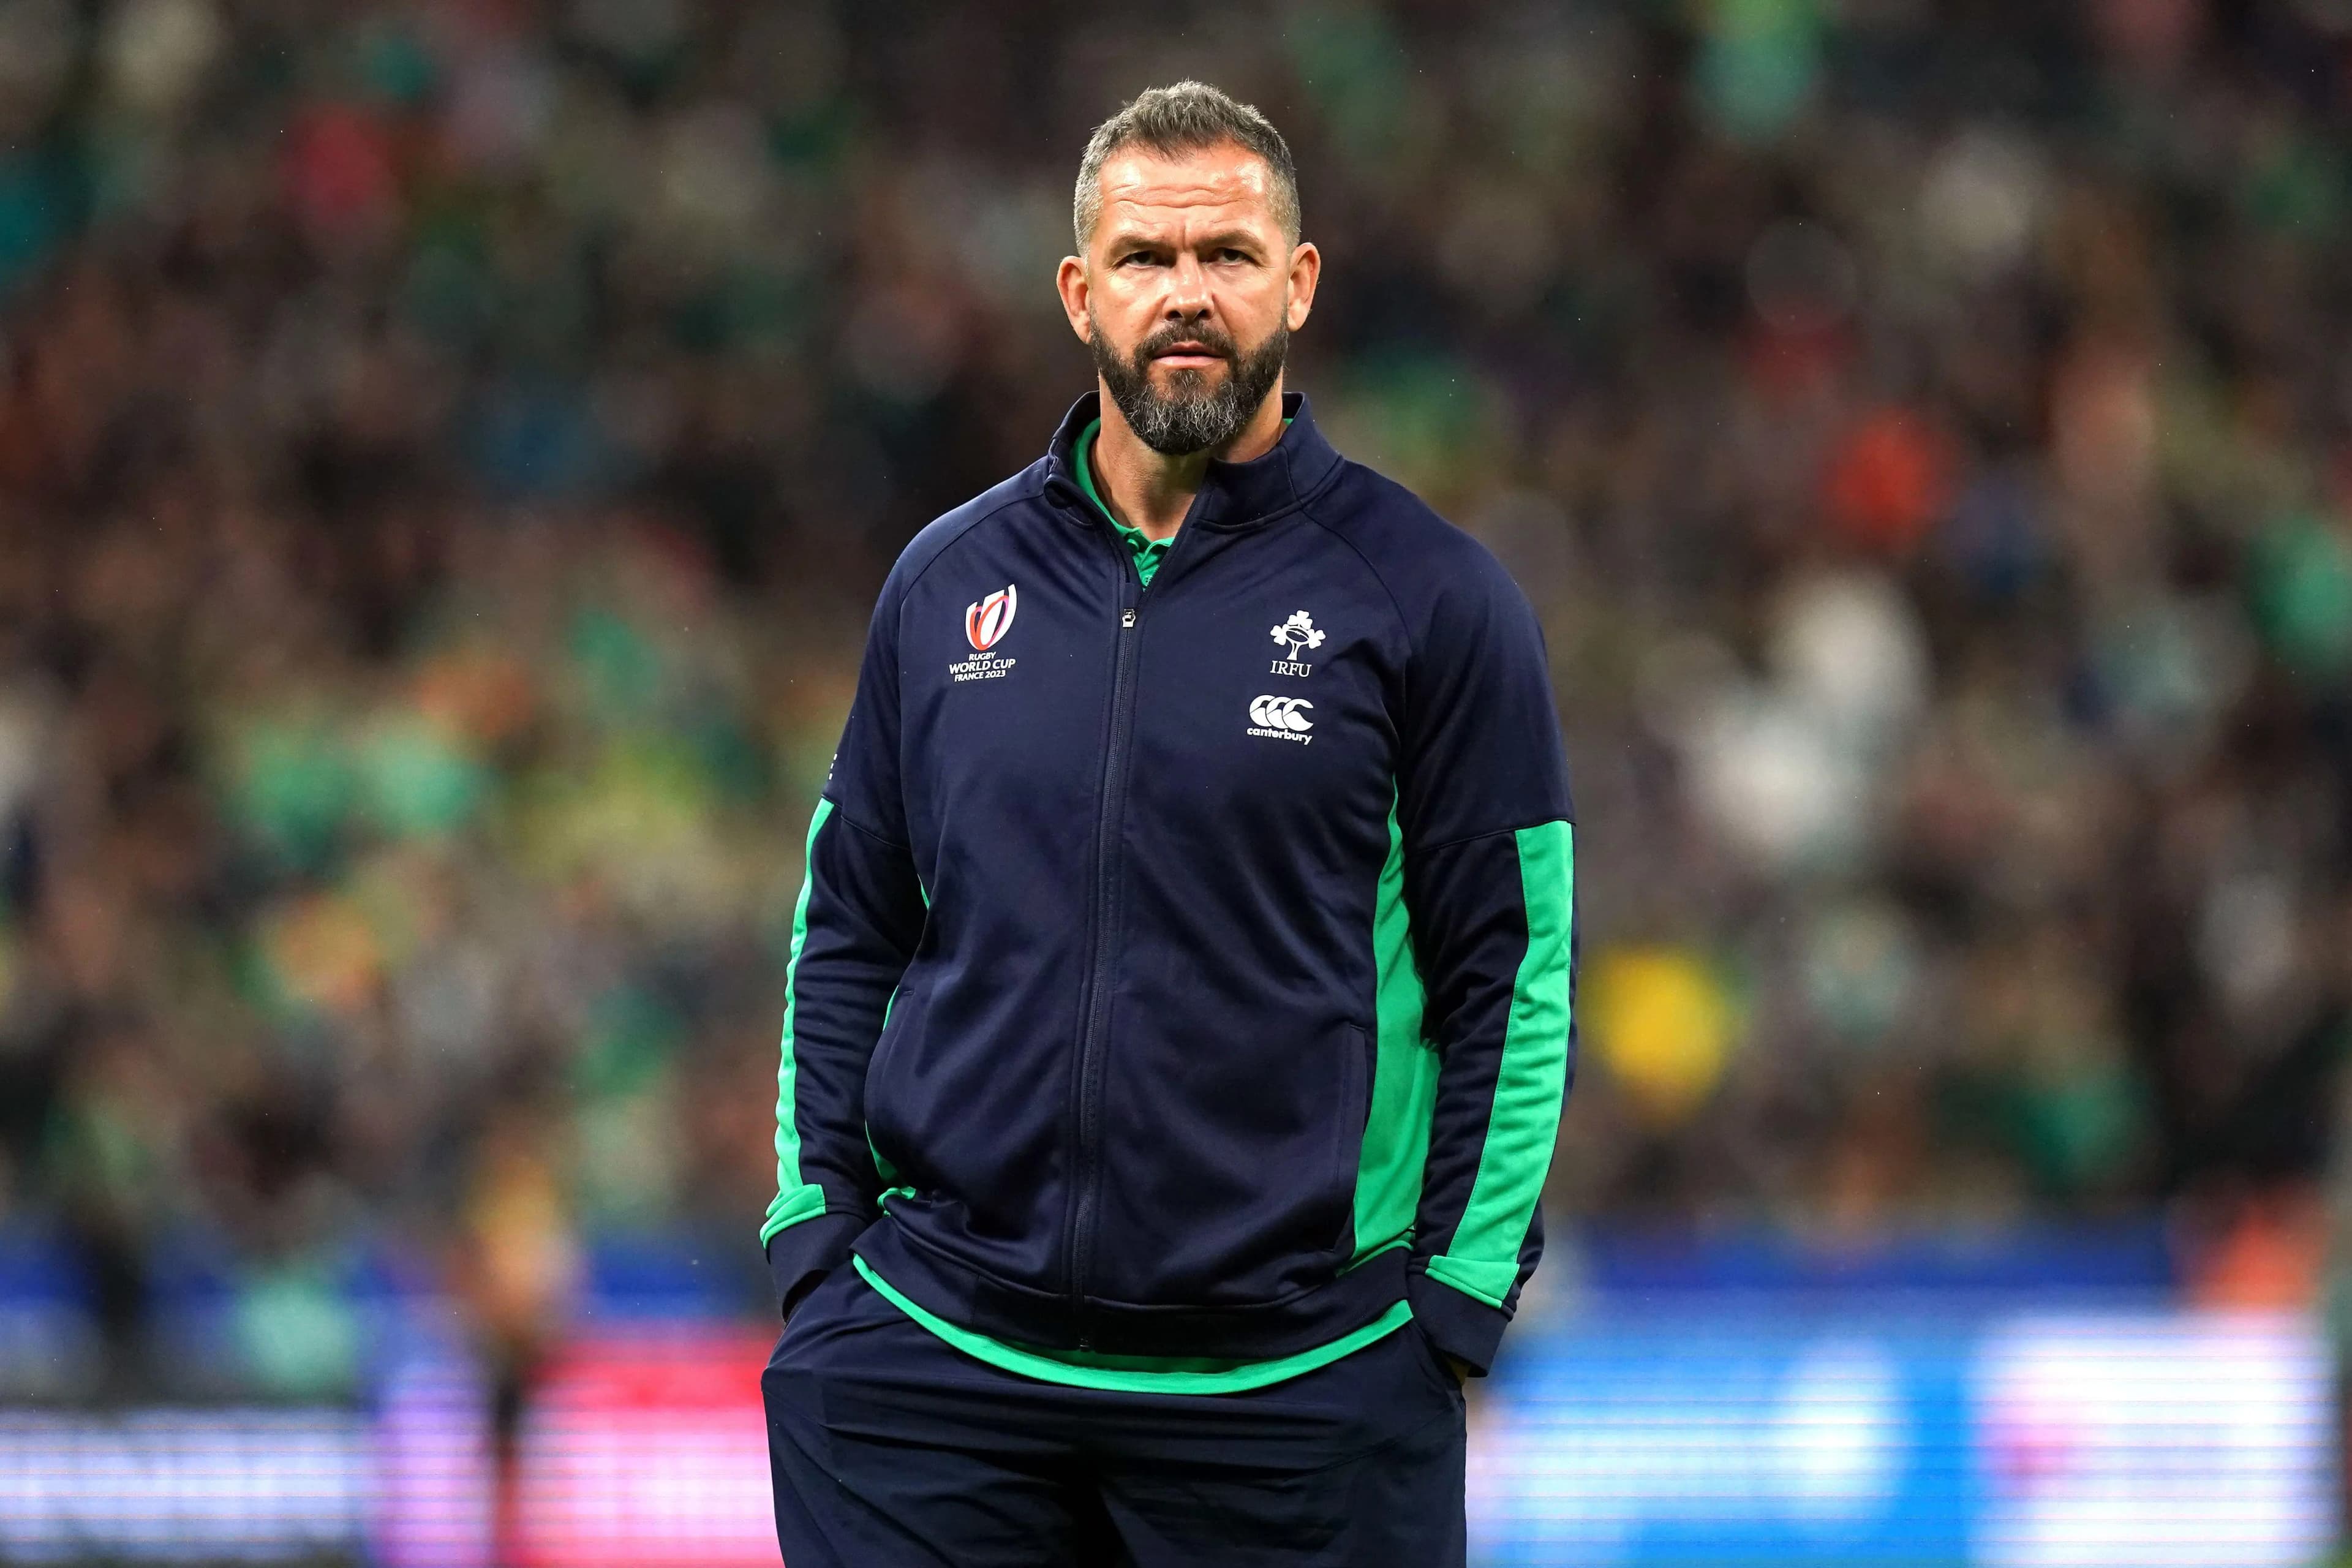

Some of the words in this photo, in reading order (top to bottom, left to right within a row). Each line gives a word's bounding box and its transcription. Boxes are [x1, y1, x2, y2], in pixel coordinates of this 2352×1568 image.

[968, 651, 997, 661] RUGBY
[949, 661, 991, 674] WORLD
[992, 658, 1016, 670] CUP
[1270, 660, 1312, 677] IRFU
[954, 671, 984, 682] FRANCE
[985, 669, 1006, 679] 2023
[1246, 727, 1313, 745] canterbury
